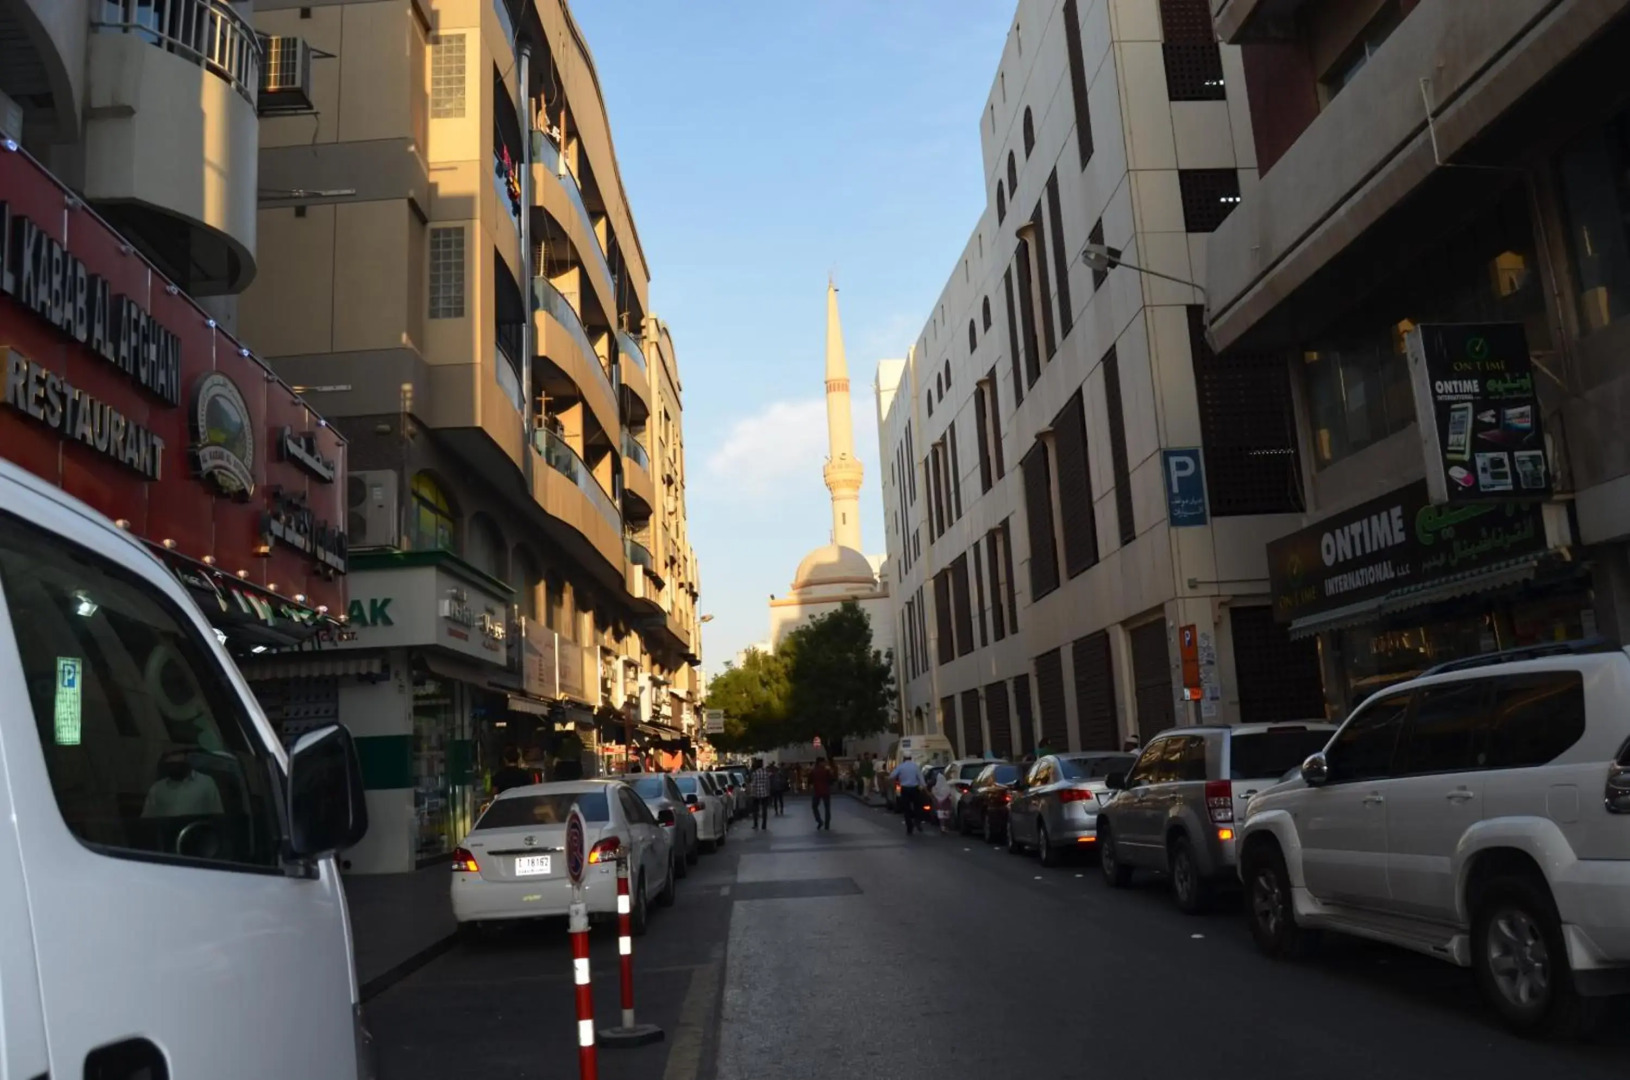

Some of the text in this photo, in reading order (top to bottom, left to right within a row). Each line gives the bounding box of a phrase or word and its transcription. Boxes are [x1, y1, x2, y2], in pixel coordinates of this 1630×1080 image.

[20, 215, 88, 343] KABAB
[92, 274, 115, 364] AL
[118, 294, 182, 408] AFGHANI
[1435, 379, 1480, 394] ONTIME
[6, 348, 165, 481] RESTAURANT
[1168, 455, 1196, 494] P
[1320, 504, 1406, 568] ONTIME
[1324, 559, 1395, 597] INTERNATIONAL
